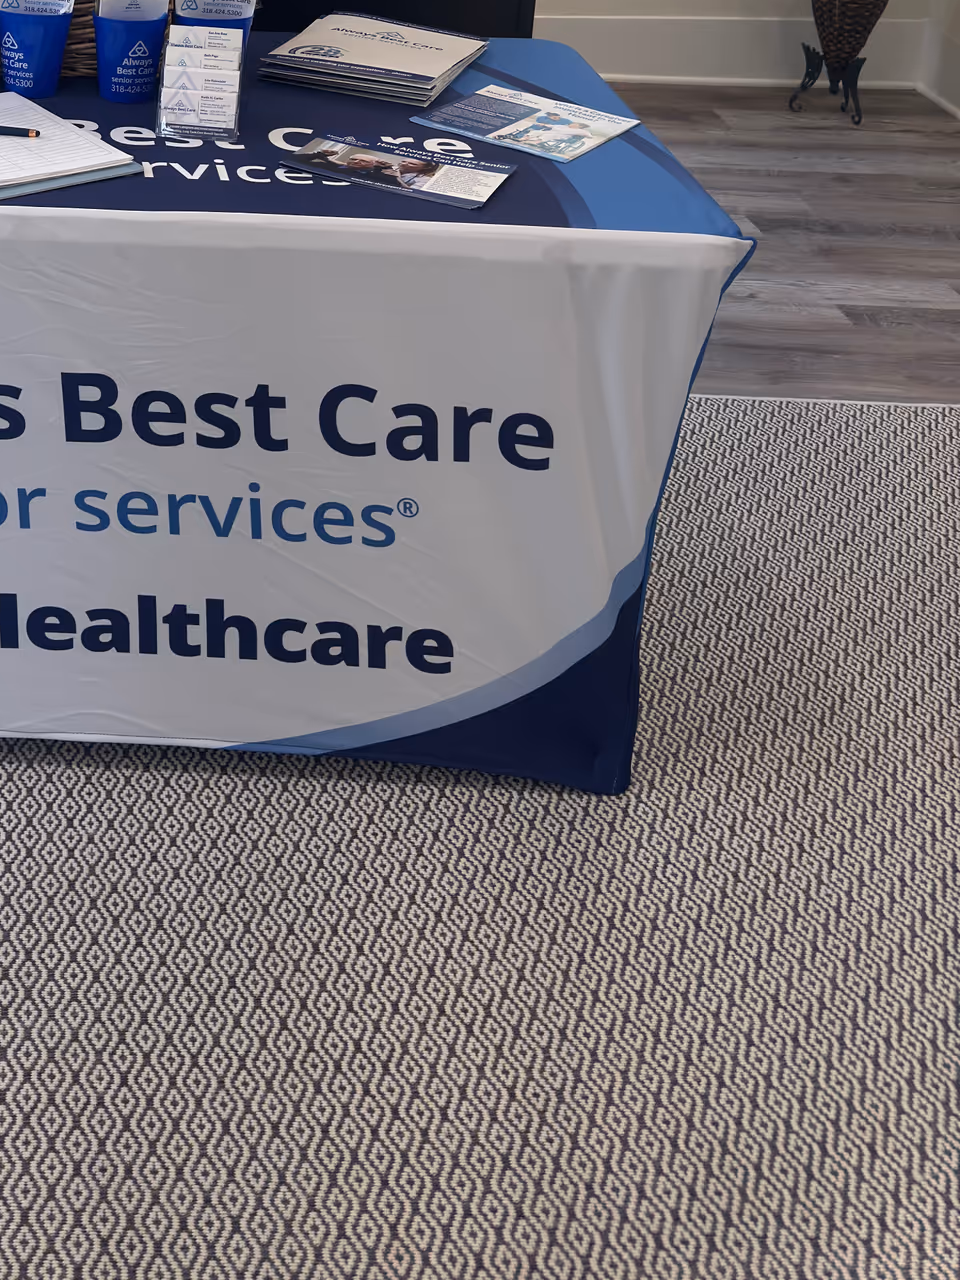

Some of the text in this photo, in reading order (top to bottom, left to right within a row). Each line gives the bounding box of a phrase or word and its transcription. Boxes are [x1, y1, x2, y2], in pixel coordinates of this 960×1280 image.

[202, 8, 242, 16] 318.424.5300
[330, 26, 444, 51] Always Best Care
[9, 60, 28, 69] Care
[122, 58, 152, 67] Always
[7, 70, 33, 78] services
[117, 67, 135, 75] Best
[393, 149, 432, 161] Services
[400, 145, 433, 156] Always
[433, 152, 455, 160] Best
[455, 155, 478, 163] Care
[478, 159, 511, 169] Senior
[62, 372, 288, 452] Best
[317, 382, 555, 472] Care
